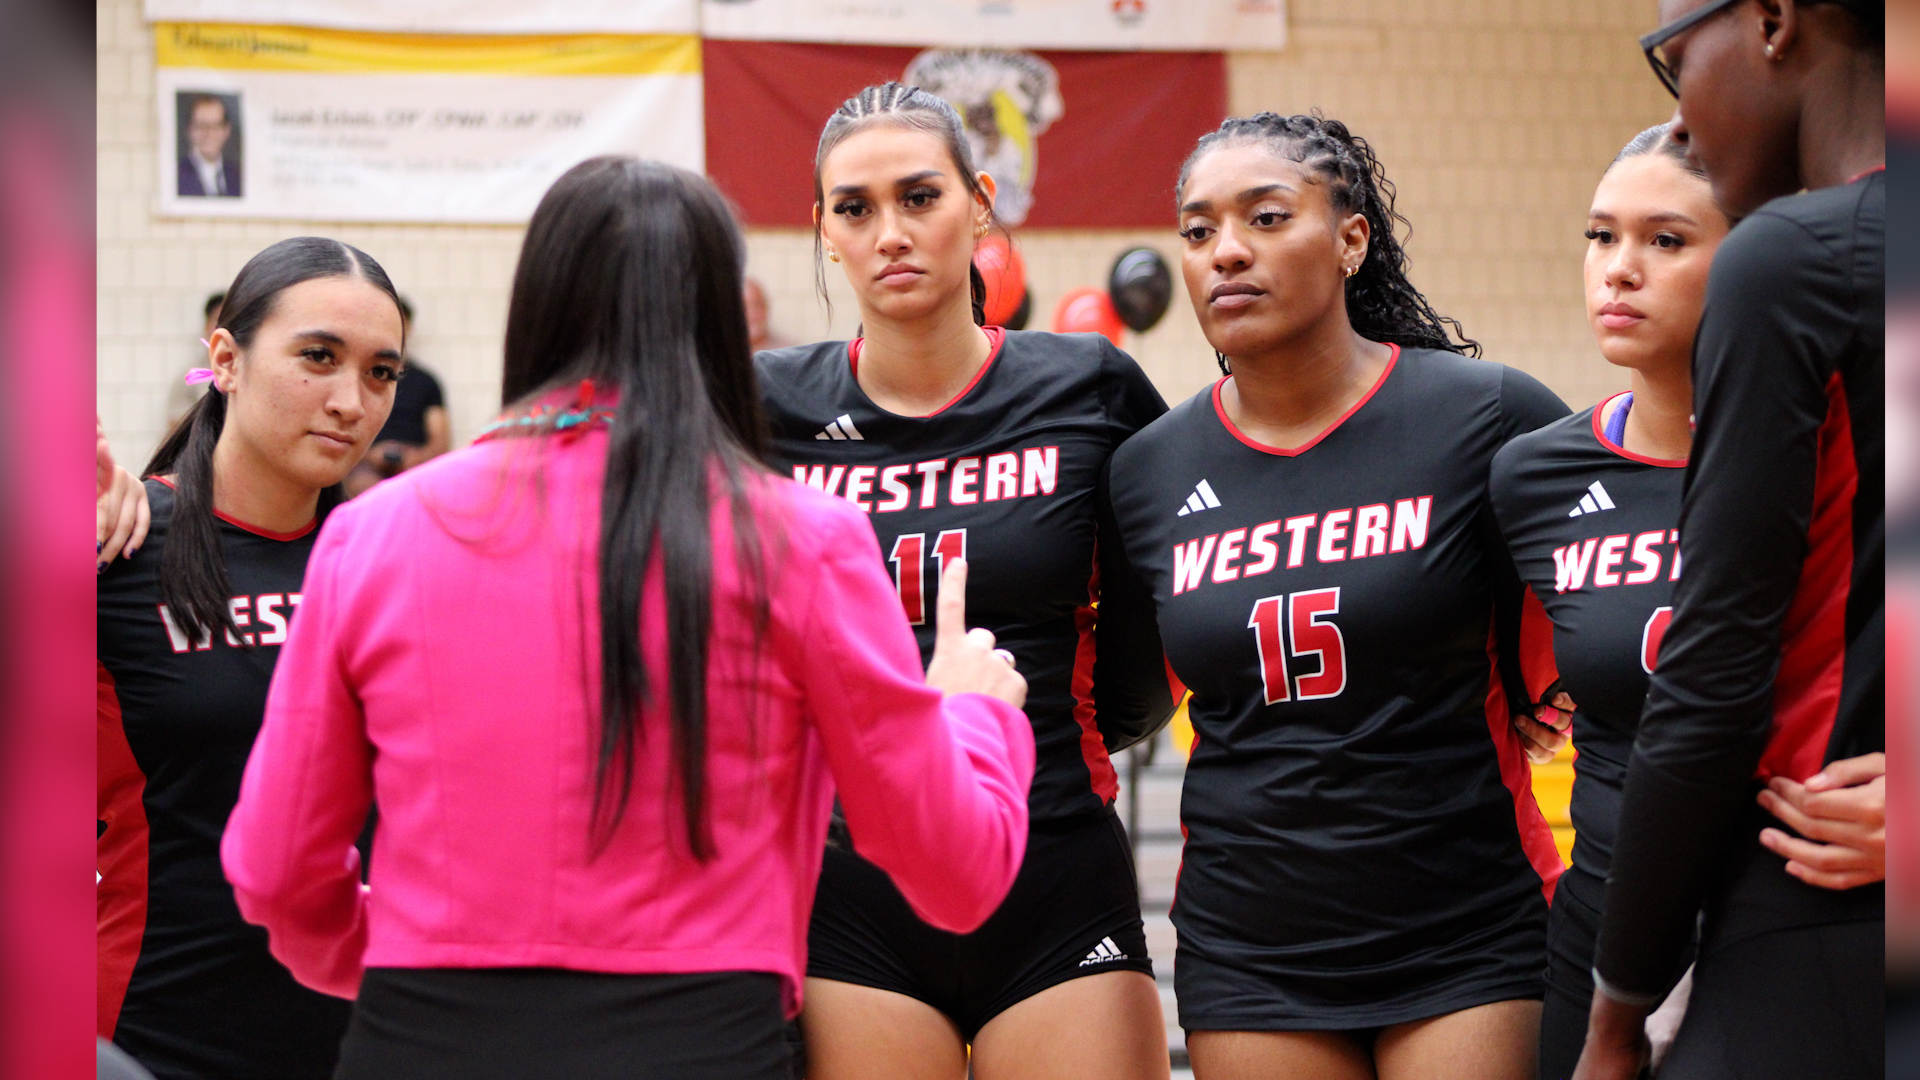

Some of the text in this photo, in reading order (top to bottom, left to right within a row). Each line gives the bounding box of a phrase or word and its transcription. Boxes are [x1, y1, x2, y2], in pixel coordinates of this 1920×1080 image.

[793, 446, 1059, 513] WESTERN
[1173, 495, 1433, 596] WESTERN
[157, 592, 304, 653] WES
[1247, 587, 1347, 706] 15
